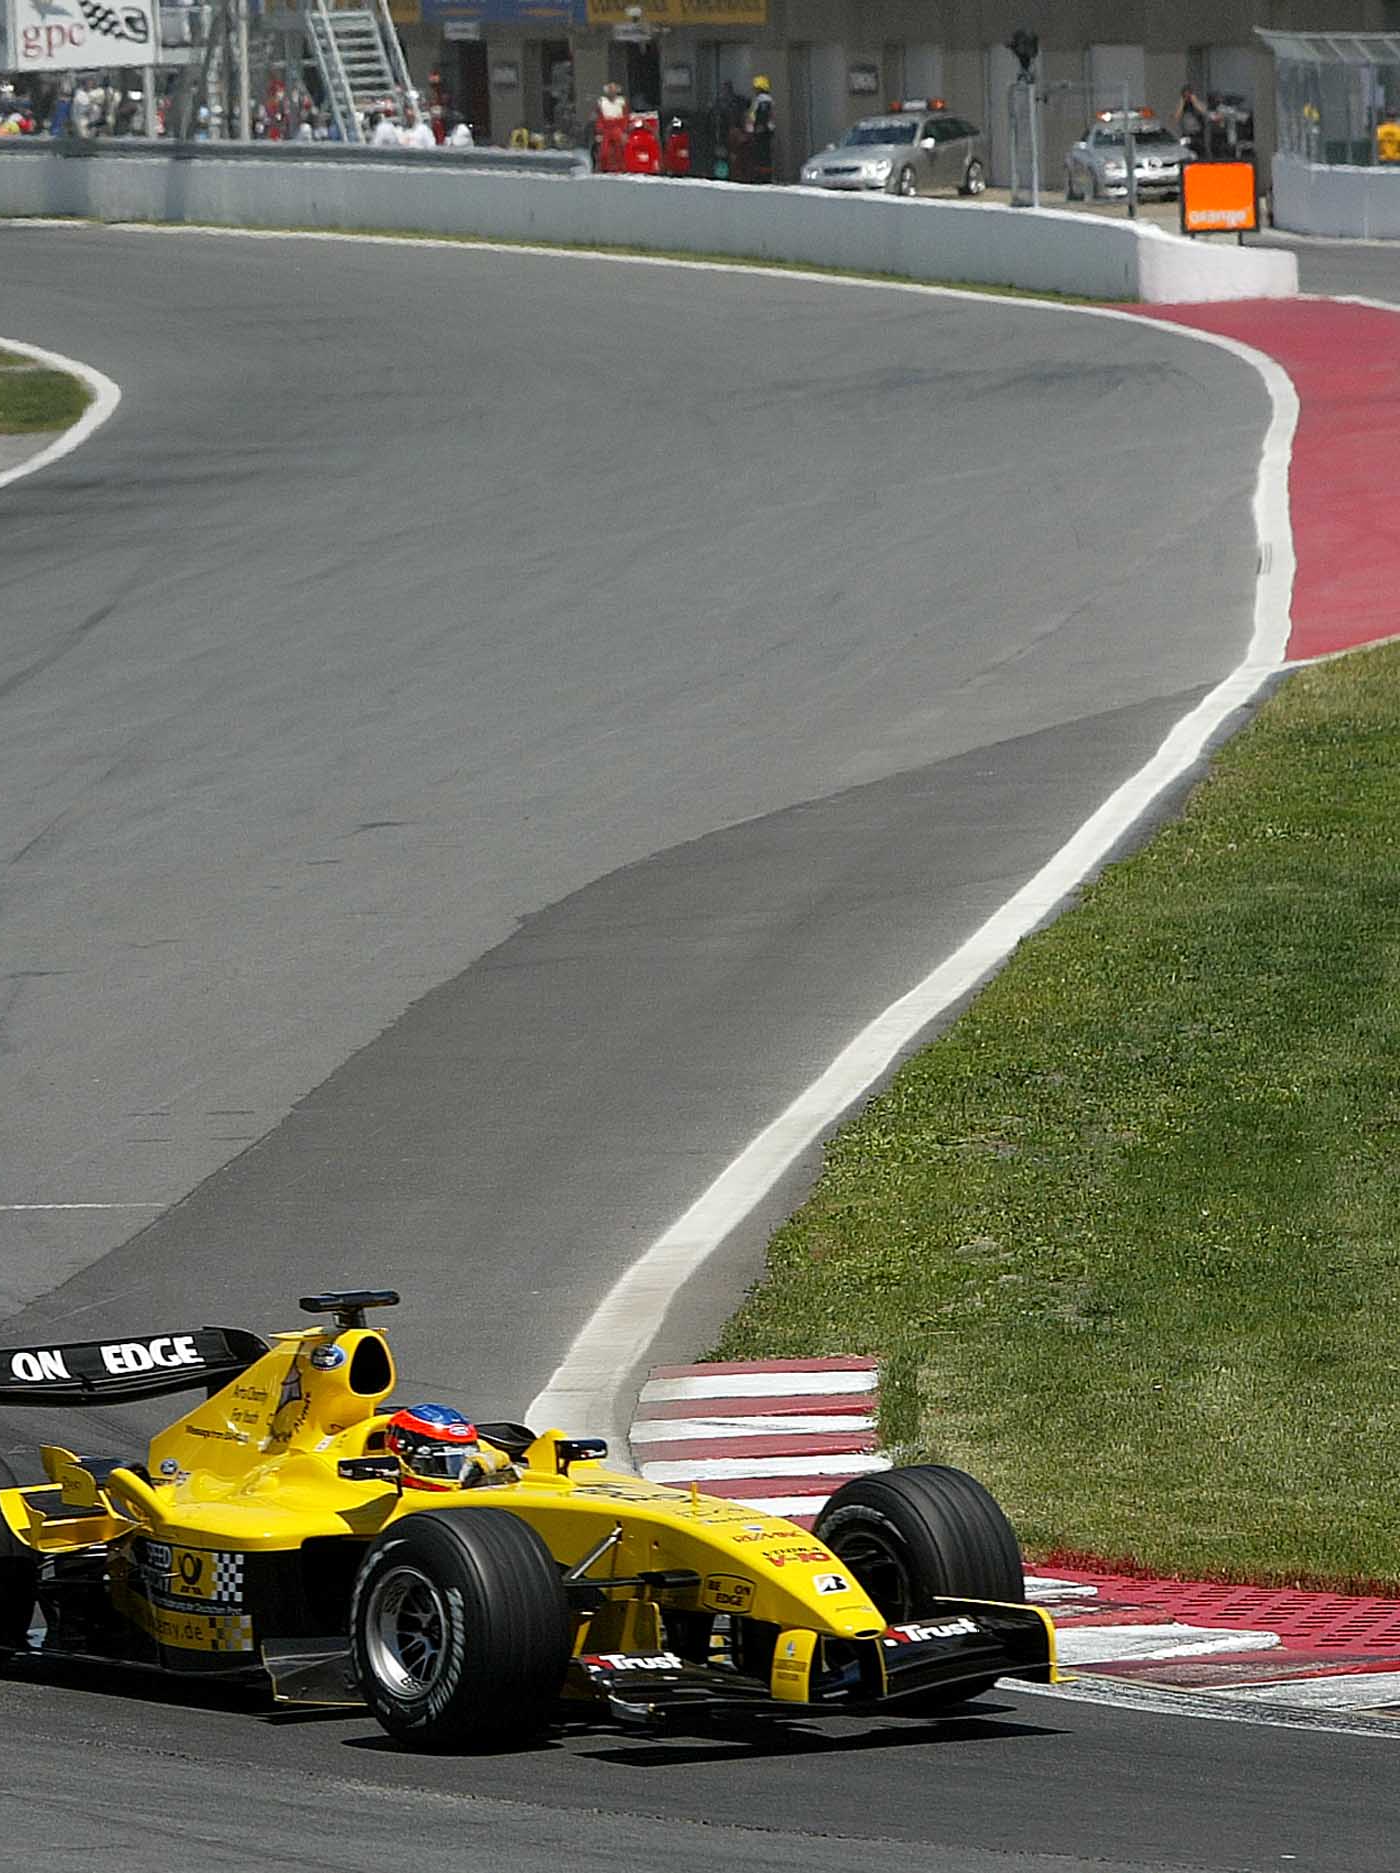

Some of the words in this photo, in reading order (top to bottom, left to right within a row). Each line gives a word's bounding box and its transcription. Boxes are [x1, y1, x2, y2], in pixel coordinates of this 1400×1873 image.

[23, 23, 87, 58] gpc
[10, 1350, 71, 1381] ON
[100, 1336, 204, 1375] EDGE
[893, 1617, 979, 1642] Trust
[598, 1651, 683, 1670] Trust
